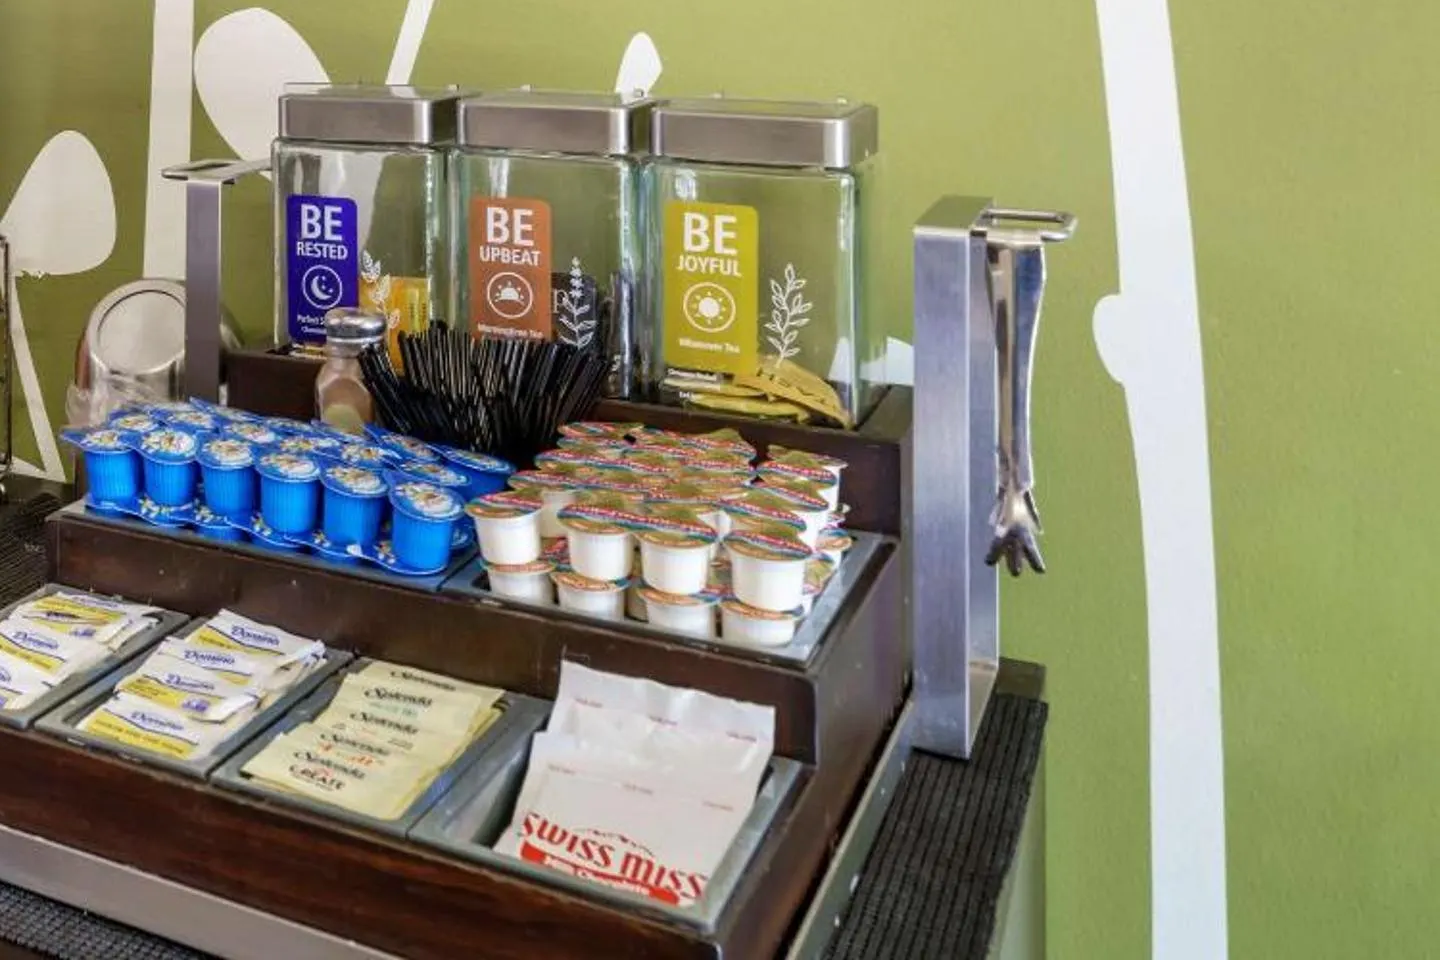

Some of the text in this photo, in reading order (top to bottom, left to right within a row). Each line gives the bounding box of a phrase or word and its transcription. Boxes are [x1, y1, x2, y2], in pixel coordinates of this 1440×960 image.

[300, 203, 343, 241] BE
[486, 206, 535, 246] BE
[683, 212, 738, 256] BE
[296, 241, 349, 260] RESTED
[479, 246, 541, 266] UPBEAT
[676, 254, 742, 277] JOYFUL
